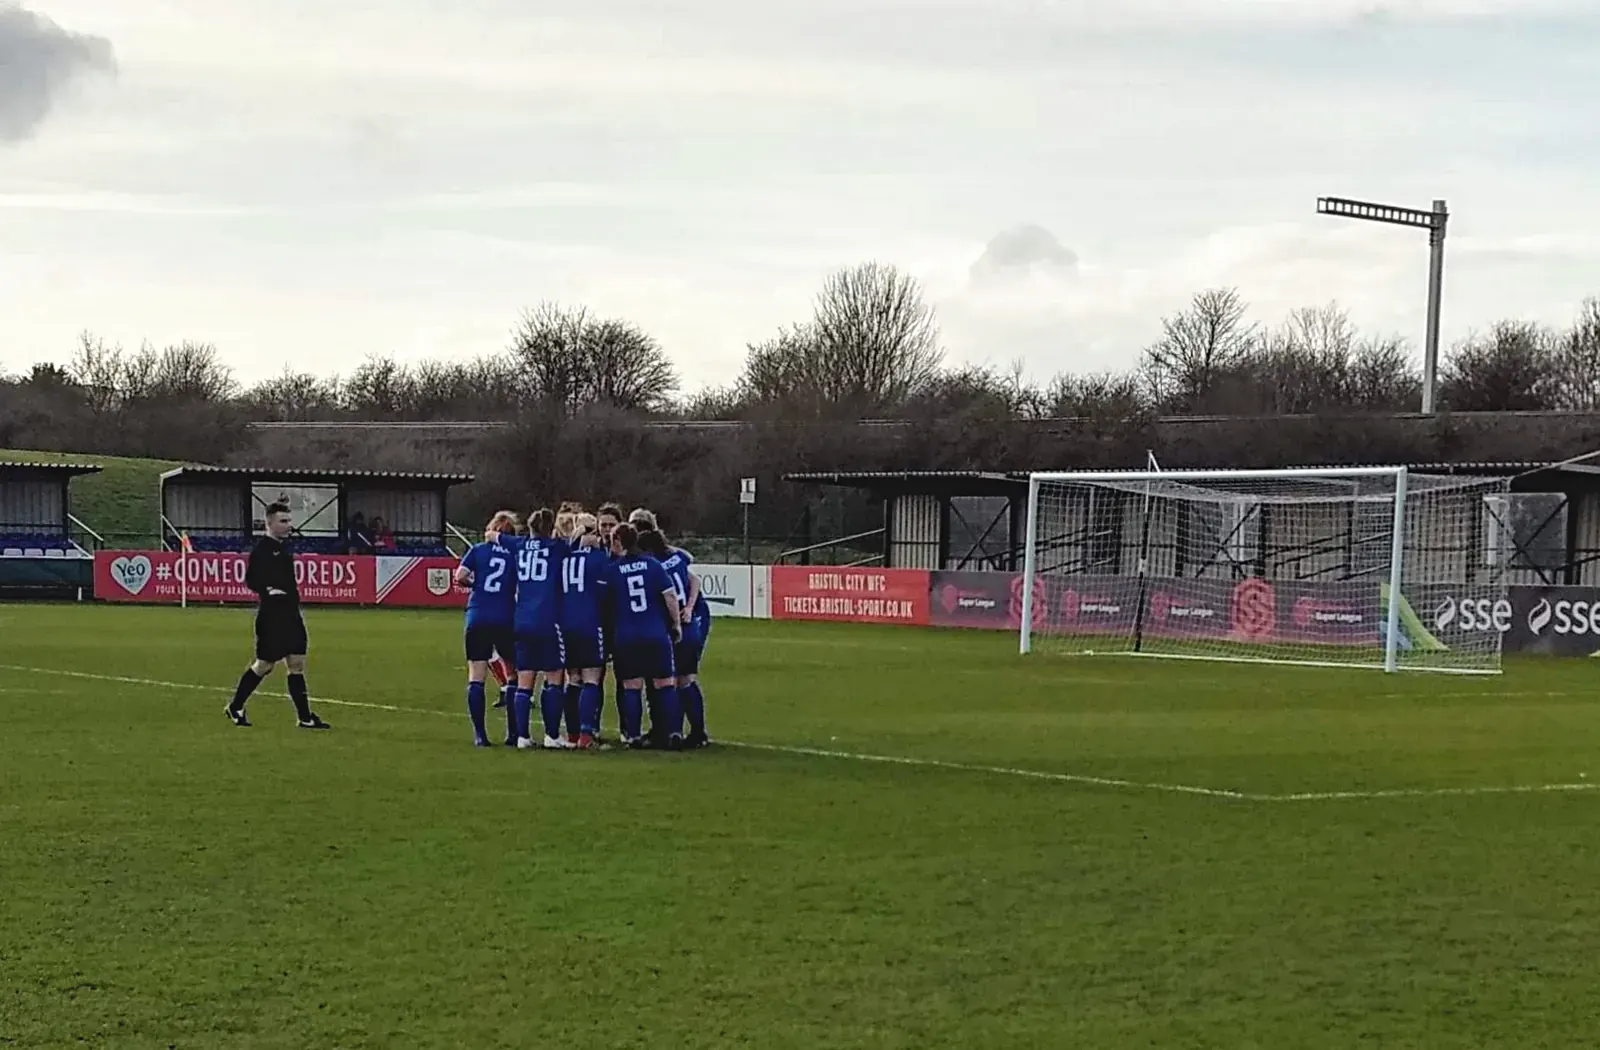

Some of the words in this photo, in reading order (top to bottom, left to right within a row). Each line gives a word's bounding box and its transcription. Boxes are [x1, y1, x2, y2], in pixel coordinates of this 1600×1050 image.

[484, 558, 506, 592] 2
[562, 556, 586, 594] 14
[619, 561, 648, 574] WILSON
[809, 573, 844, 590] BRISTOL
[846, 574, 865, 591] CITY
[867, 575, 886, 592] WFC
[627, 574, 648, 613] 5
